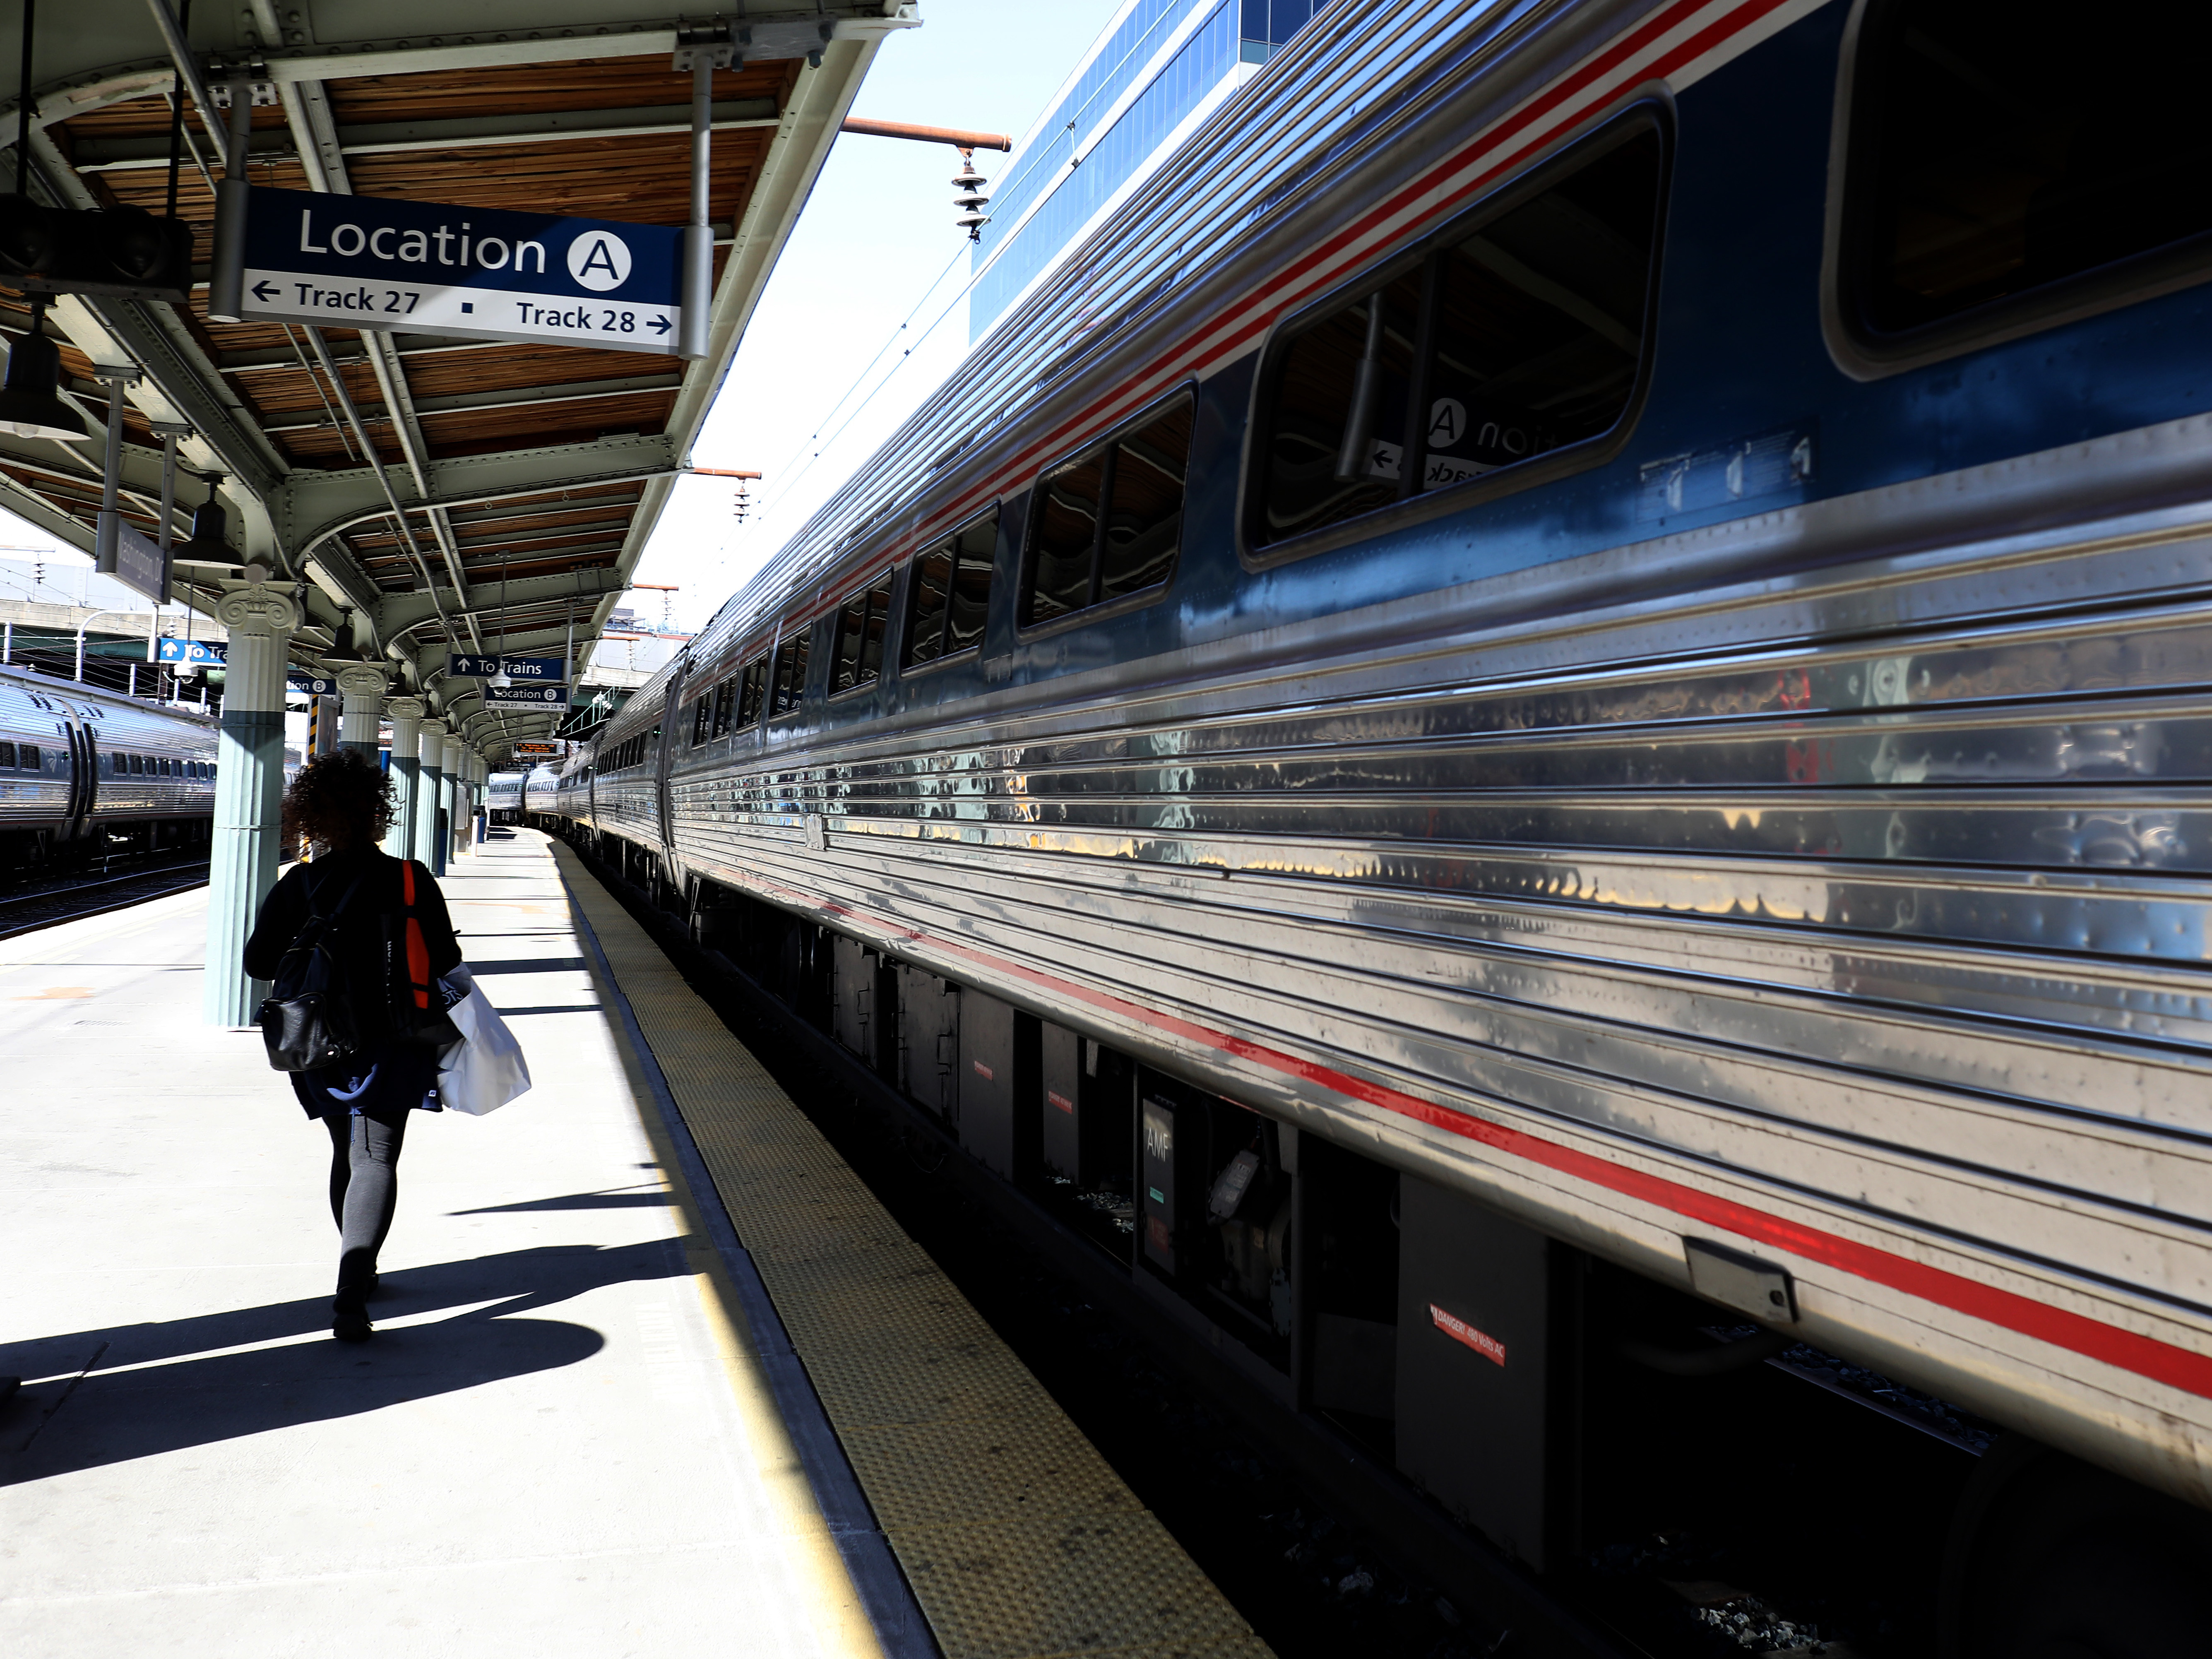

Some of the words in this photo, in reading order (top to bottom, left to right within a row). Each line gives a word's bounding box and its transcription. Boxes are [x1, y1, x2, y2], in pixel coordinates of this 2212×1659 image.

[300, 208, 546, 274] Location
[579, 239, 619, 280] A
[294, 282, 374, 311] Track
[385, 290, 420, 315] 27
[516, 302, 591, 329] Track
[602, 309, 636, 332] 28
[154, 557, 164, 585] DC
[184, 644, 205, 658] To
[208, 646, 228, 659] Tra
[478, 660, 495, 672] To
[500, 661, 542, 675] Trains
[1147, 1127, 1169, 1162] AMF
[1479, 1334, 1494, 1351] Volts
[1494, 1343, 1504, 1358] AC
